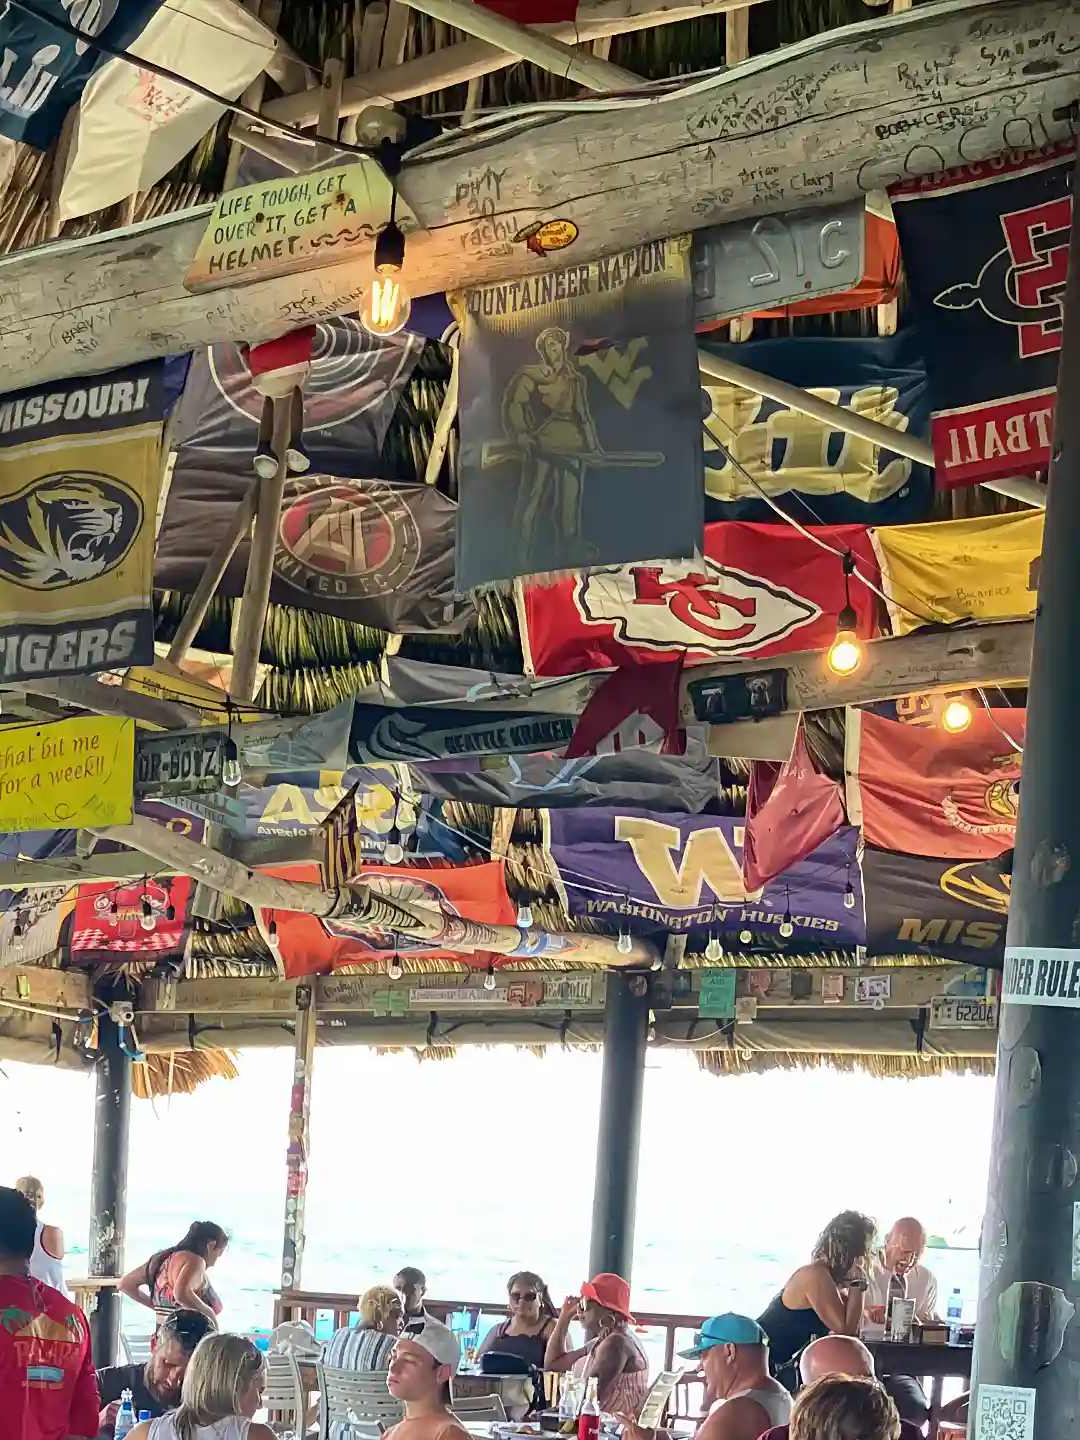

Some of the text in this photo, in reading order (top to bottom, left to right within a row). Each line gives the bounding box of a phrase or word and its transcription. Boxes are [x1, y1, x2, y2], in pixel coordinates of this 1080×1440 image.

[218, 174, 347, 219] LIFE TOUGH, GET
[214, 198, 357, 245] OVER IT, GET A
[209, 235, 303, 275] HELMET.
[597, 239, 666, 294] NATION
[41, 735, 66, 759] bit
[72, 734, 100, 752] me
[444, 717, 573, 754] SEATTLE KRAKEN
[30, 773, 41, 788] a
[614, 816, 765, 910] W
[587, 900, 844, 932] WASHINGTON HUSKIES
[897, 918, 1004, 949] MIS
[1036, 961, 1080, 1001] RULE
